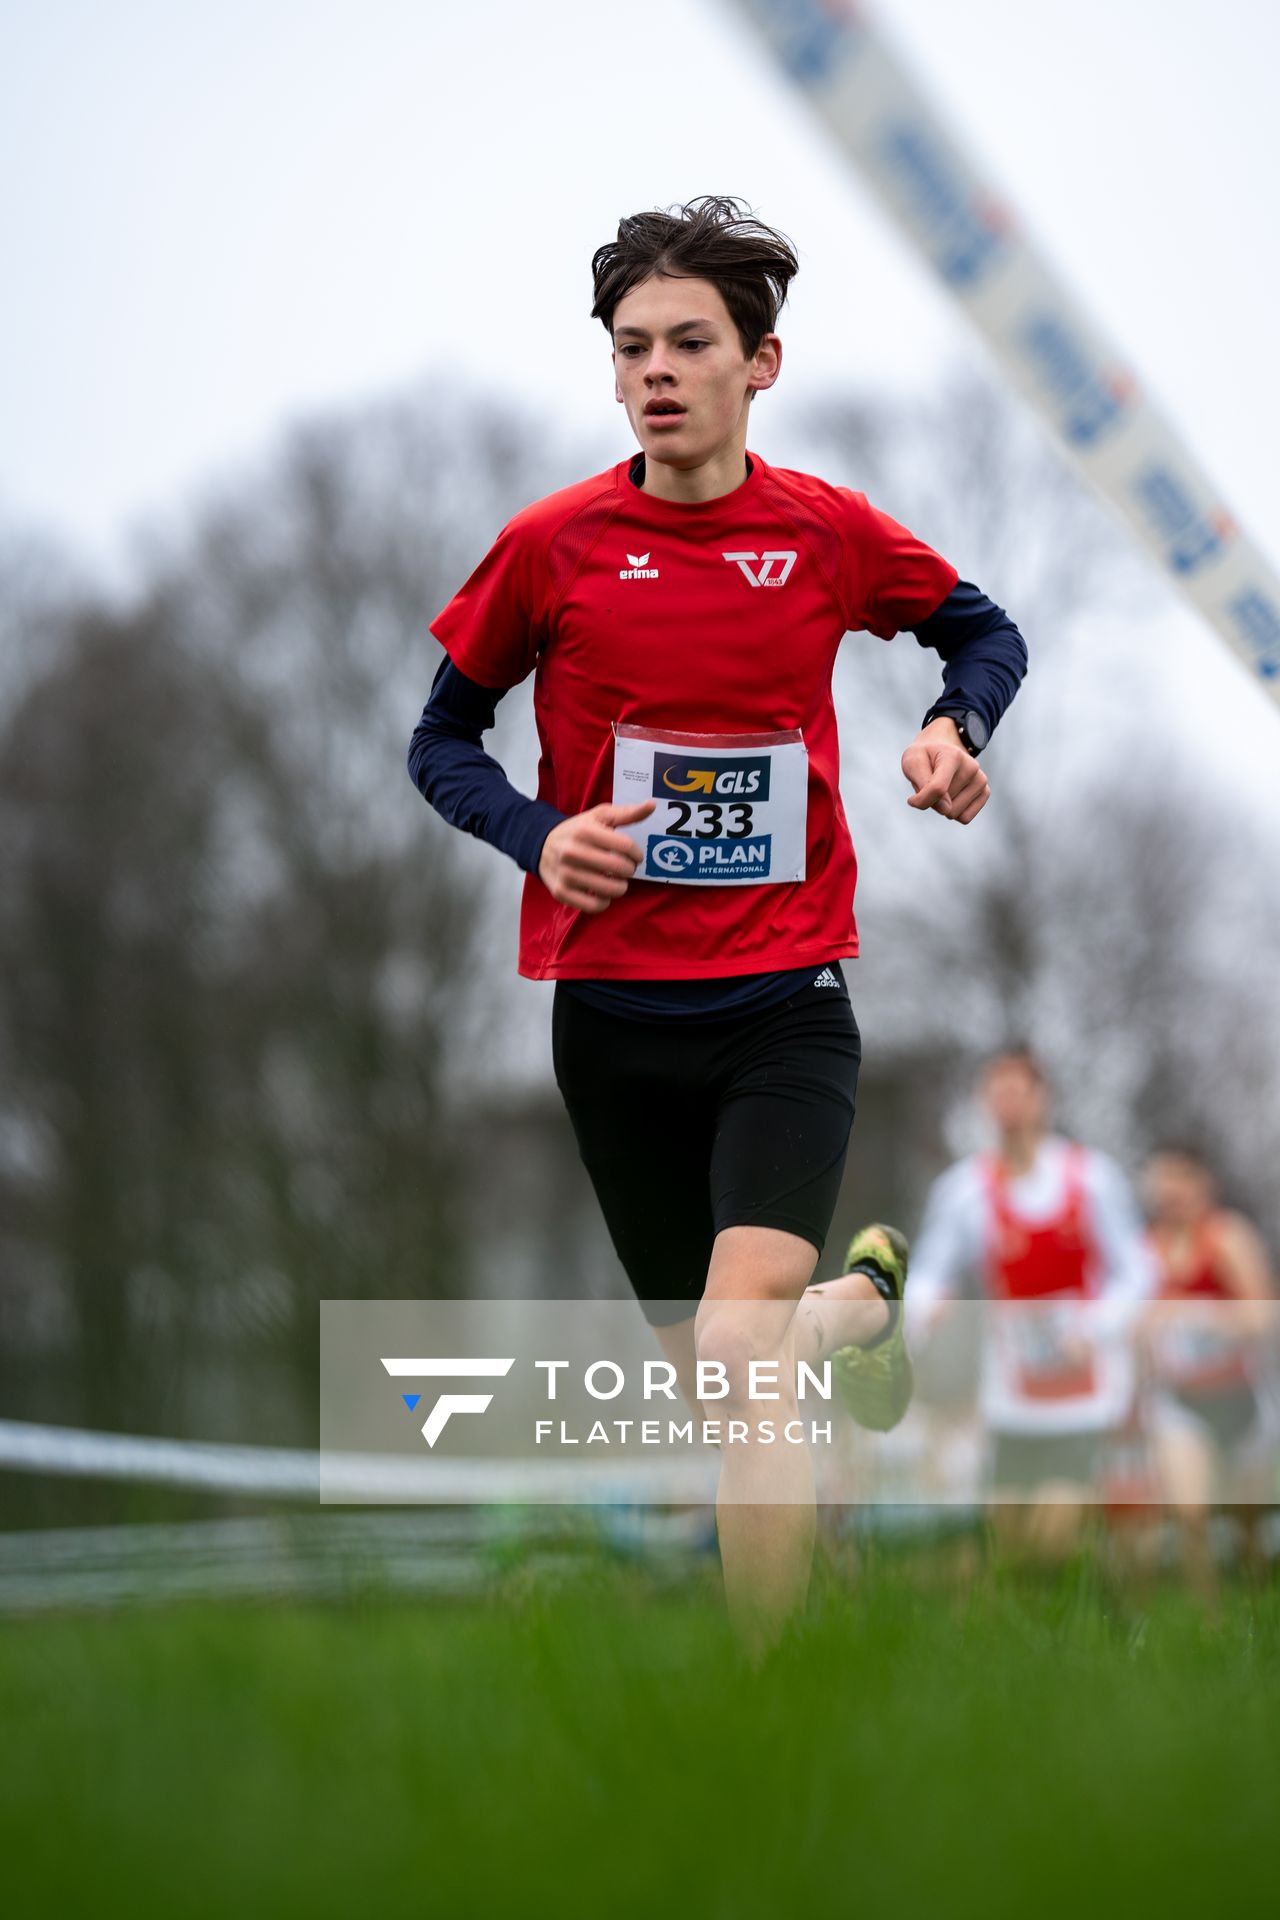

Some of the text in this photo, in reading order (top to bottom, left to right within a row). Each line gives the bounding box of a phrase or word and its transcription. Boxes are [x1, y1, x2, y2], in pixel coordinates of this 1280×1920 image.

[619, 568, 659, 580] erima
[715, 770, 761, 794] GLS
[665, 801, 754, 839] 233
[699, 845, 766, 864] PLAN
[699, 866, 764, 874] INTERNATIONAL
